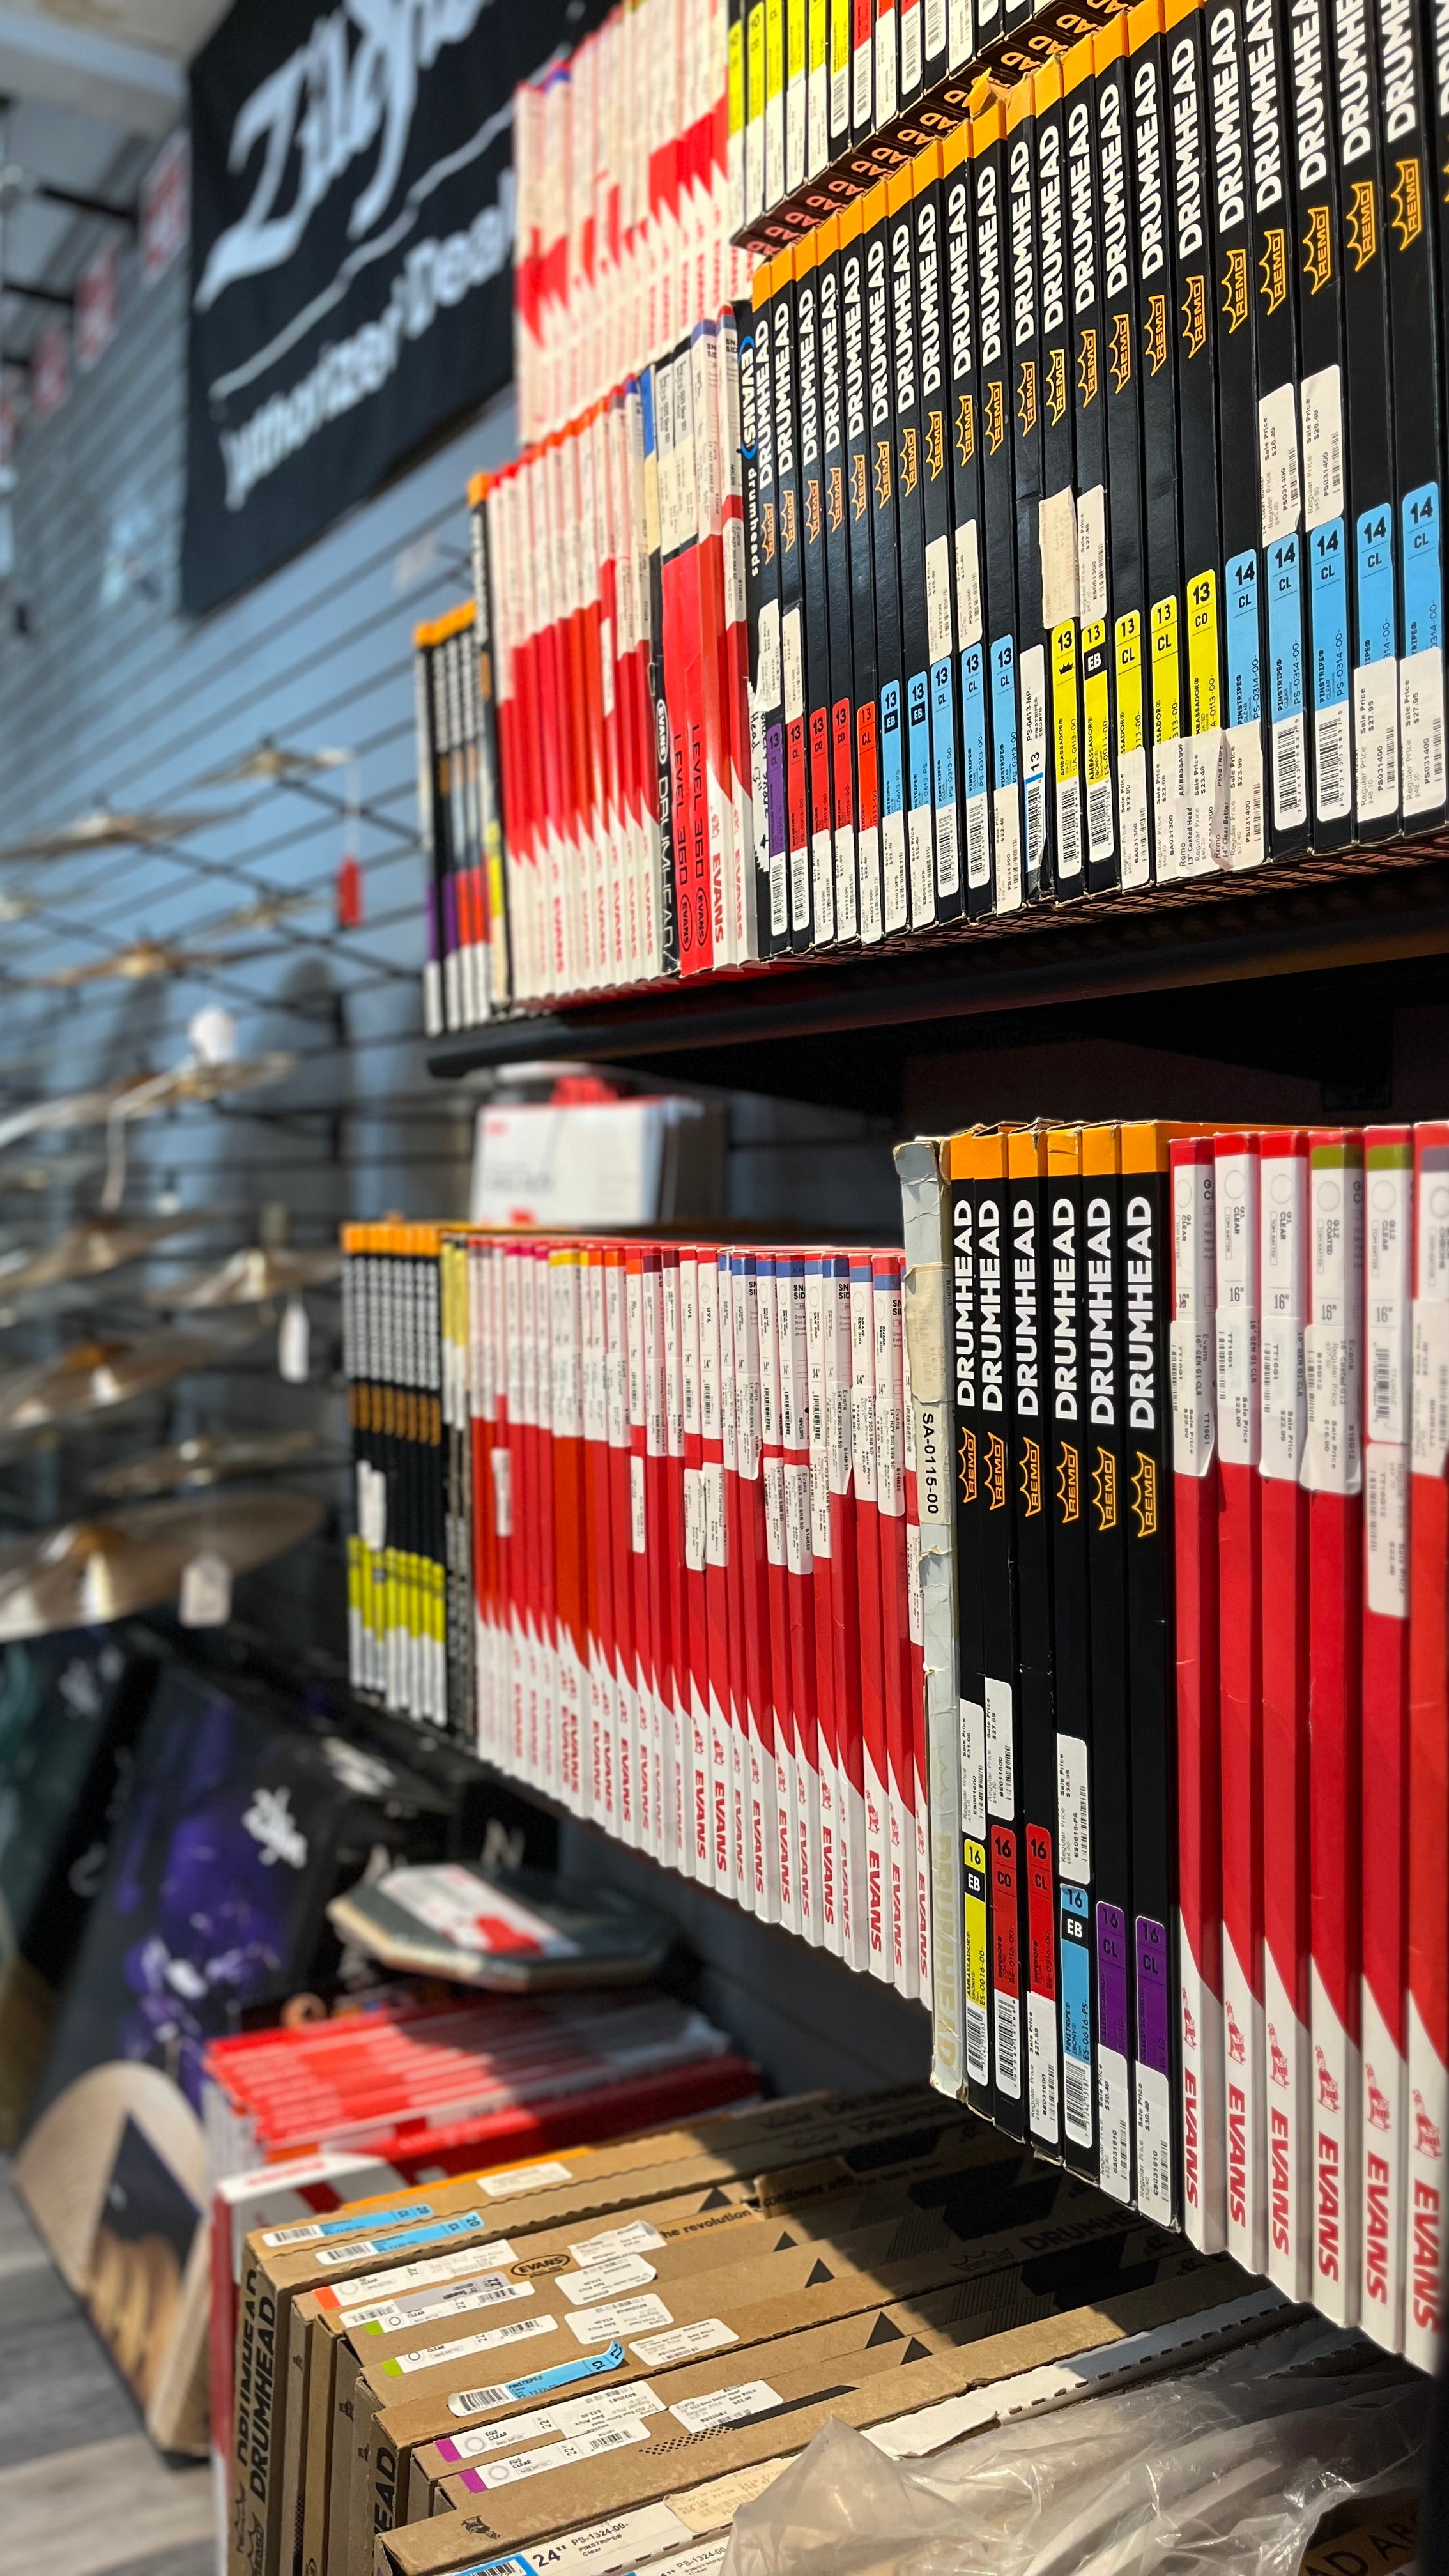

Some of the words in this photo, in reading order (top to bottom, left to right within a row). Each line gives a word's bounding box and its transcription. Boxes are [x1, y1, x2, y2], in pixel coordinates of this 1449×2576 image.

[1211, 9, 1245, 233] DRUMHEAD
[1135, 62, 1164, 280] DRUMHEAD
[1172, 38, 1203, 259] DRUMHEAD
[1069, 103, 1095, 314] DRUMHEAD
[1100, 84, 1128, 299] DRUMHEAD
[1010, 141, 1035, 346] DRUMHEAD
[1040, 126, 1064, 334] DRUMHEAD
[948, 183, 971, 381] DRUMHEAD
[978, 165, 1002, 367] DRUMHEAD
[893, 224, 915, 414] DRUMHEAD
[917, 204, 940, 397] DRUMHEAD
[843, 257, 863, 441] DRUMHEAD
[866, 240, 888, 428] DRUMHEAD
[776, 303, 793, 477] DRUMHEAD
[799, 289, 817, 466] DRUMHEAD
[748, 467, 760, 577] drumheads
[1363, 516, 1386, 544] 14
[1410, 496, 1432, 524] 14
[1275, 542, 1295, 568] 14
[1317, 530, 1338, 556] 14
[1368, 553, 1382, 568] CL
[1414, 533, 1429, 548] CL
[1193, 581, 1210, 605] 13
[1236, 560, 1255, 586] 14
[1279, 576, 1291, 591] CL
[1321, 565, 1334, 579] CL
[1157, 603, 1172, 625] 13
[1195, 612, 1208, 627] CO
[1239, 594, 1251, 608] CL
[1058, 630, 1072, 652] 13
[1087, 625, 1100, 643] 13
[1121, 618, 1135, 637] 13
[1158, 634, 1171, 651] CL
[935, 667, 947, 686] 13
[966, 654, 979, 673] 13
[998, 647, 1011, 668] 13
[1087, 652, 1101, 671] EB
[1121, 647, 1135, 664] CL
[1335, 629, 1344, 696] PS-0314-00-
[885, 691, 897, 709] 13
[912, 683, 924, 702] 13
[914, 708, 923, 720] EB
[674, 734, 685, 819] LEVEL
[691, 724, 703, 810] LEVEL
[1031, 751, 1039, 771] 13
[677, 826, 687, 886] 360
[694, 820, 705, 879] 360
[712, 852, 724, 944] EVANS
[954, 1200, 974, 1407] DRUMHEAD
[979, 1200, 1002, 1411] DRUMHEAD
[1014, 1200, 1038, 1415] DRUMHEAD
[1053, 1199, 1077, 1420] DRUMHEAD
[1087, 1198, 1114, 1424] DRUMHEAD
[1126, 1197, 1154, 1429] DRUMHEAD
[1230, 1287, 1244, 1301] 16"
[1274, 1294, 1289, 1309] 16"
[1322, 1305, 1337, 1320] 16"
[922, 1413, 939, 1514] SA-0115-00
[621, 1738, 631, 1822] EVANS
[695, 1770, 705, 1860] EVANS
[753, 1800, 763, 1893] EVANS
[779, 1809, 790, 1904] EVANS
[799, 1820, 809, 1917] EVANS
[969, 1846, 981, 1865] 16
[995, 1837, 1011, 1858] 16
[1031, 1837, 1047, 1860] 16
[822, 1825, 834, 1925] EVANS
[968, 1873, 980, 1892] EB
[997, 1871, 1011, 1887] CO
[869, 1850, 882, 1952] EVANS
[892, 1862, 902, 1968] EVANS
[1068, 1889, 1082, 1908] 16
[1103, 1908, 1118, 1928] 16
[918, 1871, 927, 1978] EVANS
[1067, 1918, 1082, 1938] EB
[1144, 1924, 1159, 1943] 16
[1103, 1939, 1118, 1958] CL
[1143, 1954, 1158, 1974] CL
[1184, 2066, 1197, 2209] EVANS
[1228, 2083, 1246, 2227] EVANS
[1271, 2106, 1289, 2256] EVANS
[465, 2216, 480, 2227] 20
[684, 2209, 751, 2234] revolution
[1318, 2132, 1338, 2283] EVANS
[1367, 2150, 1388, 2306] EVANS
[1413, 2179, 1439, 2331] EVANS
[610, 2343, 623, 2358] 22
[533, 2547, 567, 2568] 24"
[571, 2523, 629, 2547] PS-1324-00-
[582, 2545, 601, 2556] Clear
